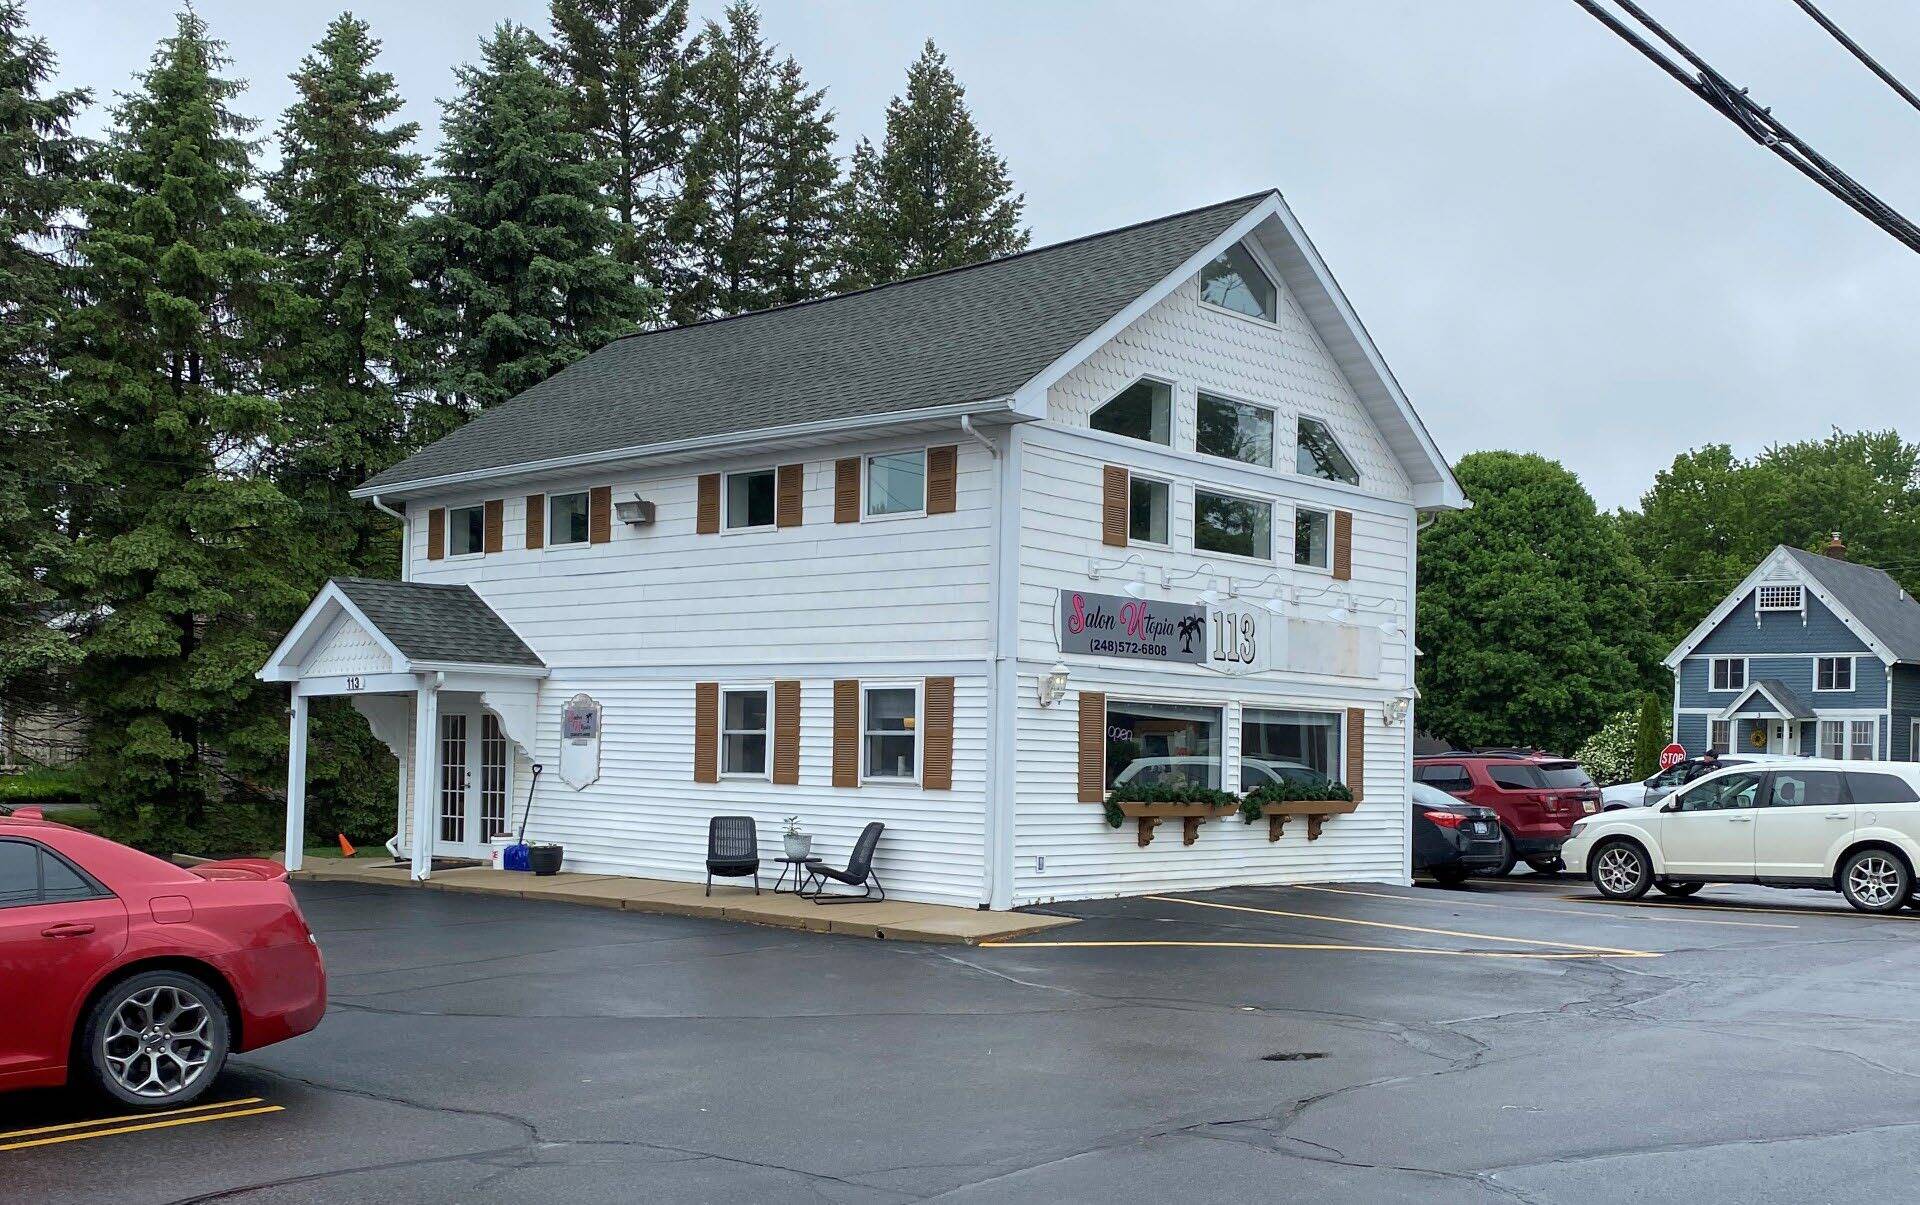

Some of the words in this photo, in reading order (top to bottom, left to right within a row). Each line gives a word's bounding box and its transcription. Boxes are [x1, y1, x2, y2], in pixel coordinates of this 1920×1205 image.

[1068, 593, 1116, 634] Salon
[1120, 601, 1174, 641] Utopia
[1213, 610, 1256, 664] 113
[1090, 638, 1167, 656] (248)572-6808
[347, 676, 360, 690] 113
[1662, 752, 1684, 765] STOP
